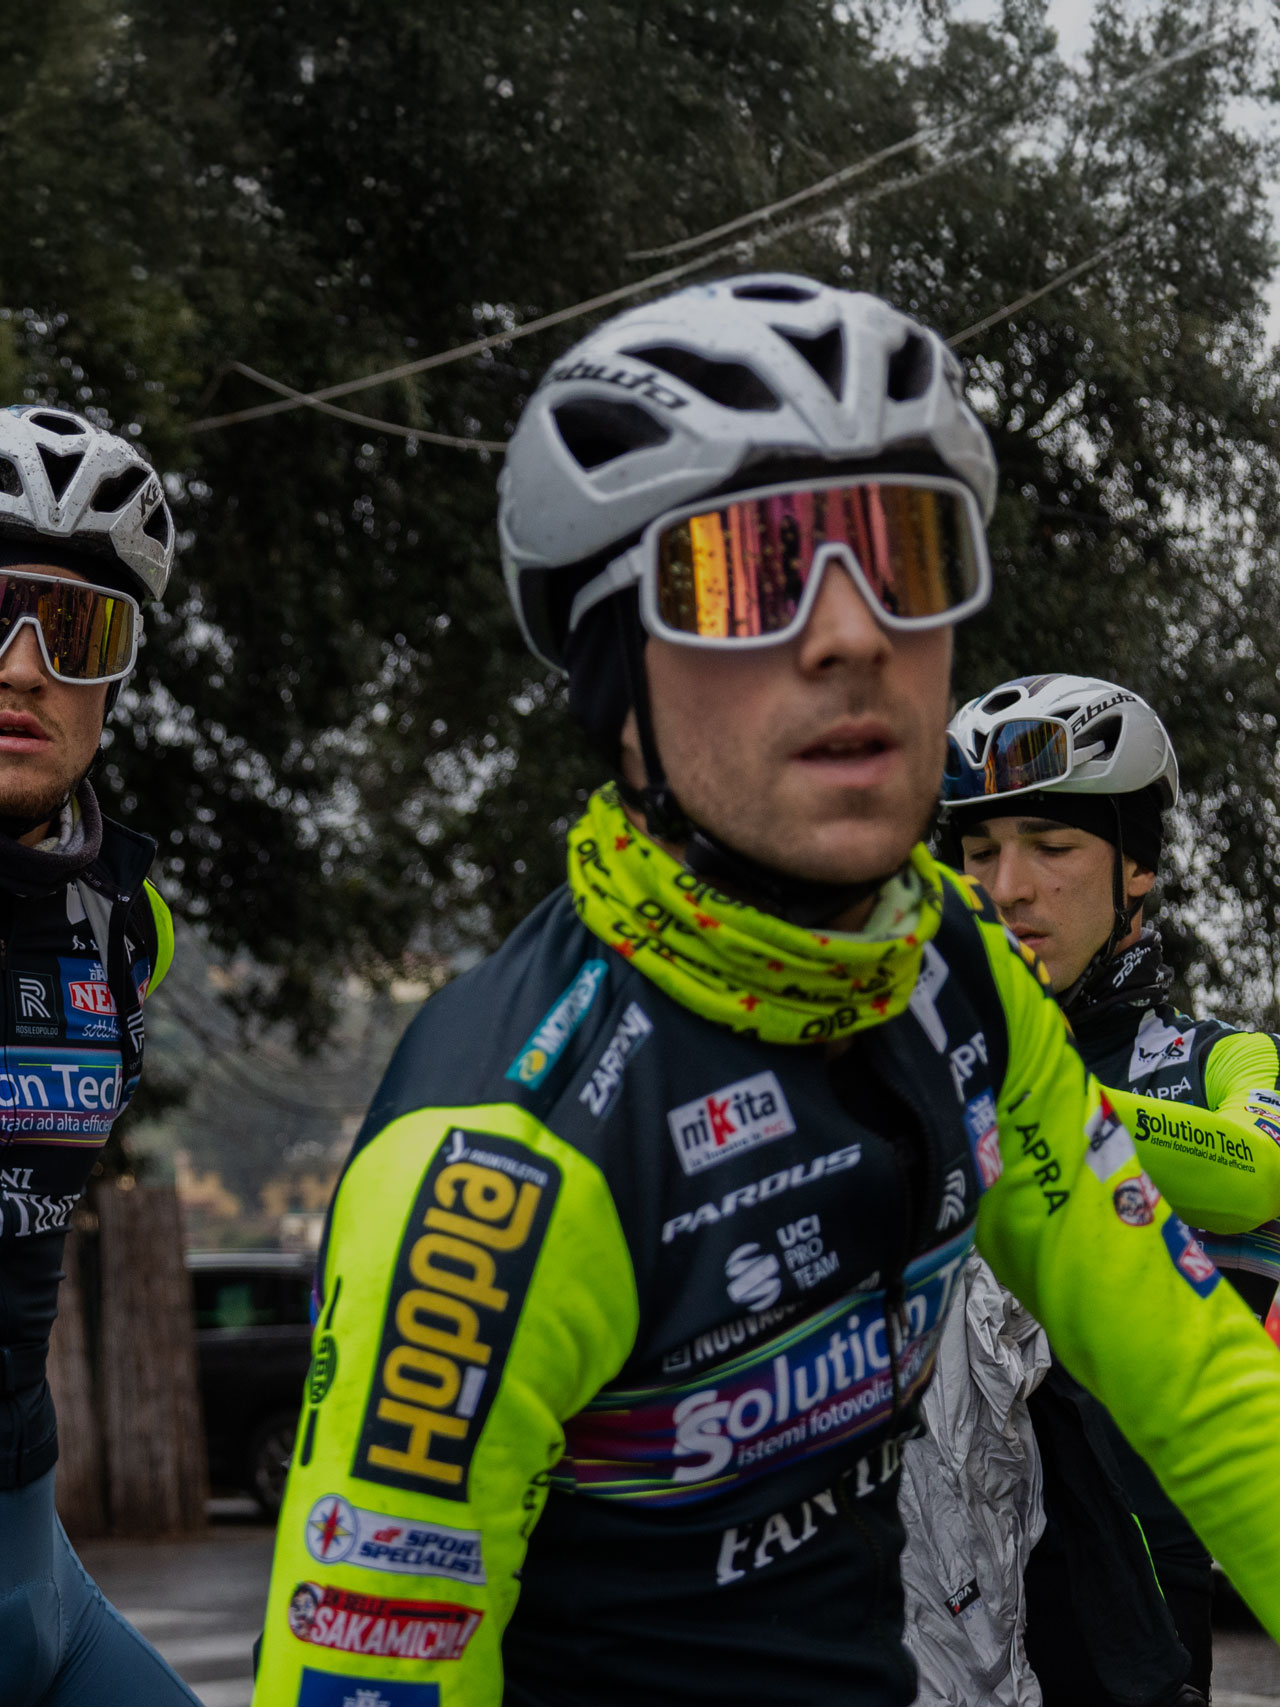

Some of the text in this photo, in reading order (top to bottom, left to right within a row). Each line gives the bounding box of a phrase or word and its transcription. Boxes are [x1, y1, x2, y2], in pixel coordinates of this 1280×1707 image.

[36, 1114, 54, 1130] ad
[57, 1114, 81, 1132] alta
[1216, 1130, 1253, 1162] Tech
[661, 1144, 862, 1244] PARDUS
[776, 1214, 821, 1249] UCI
[784, 1237, 823, 1271] PRO
[793, 1251, 841, 1291] TEAM
